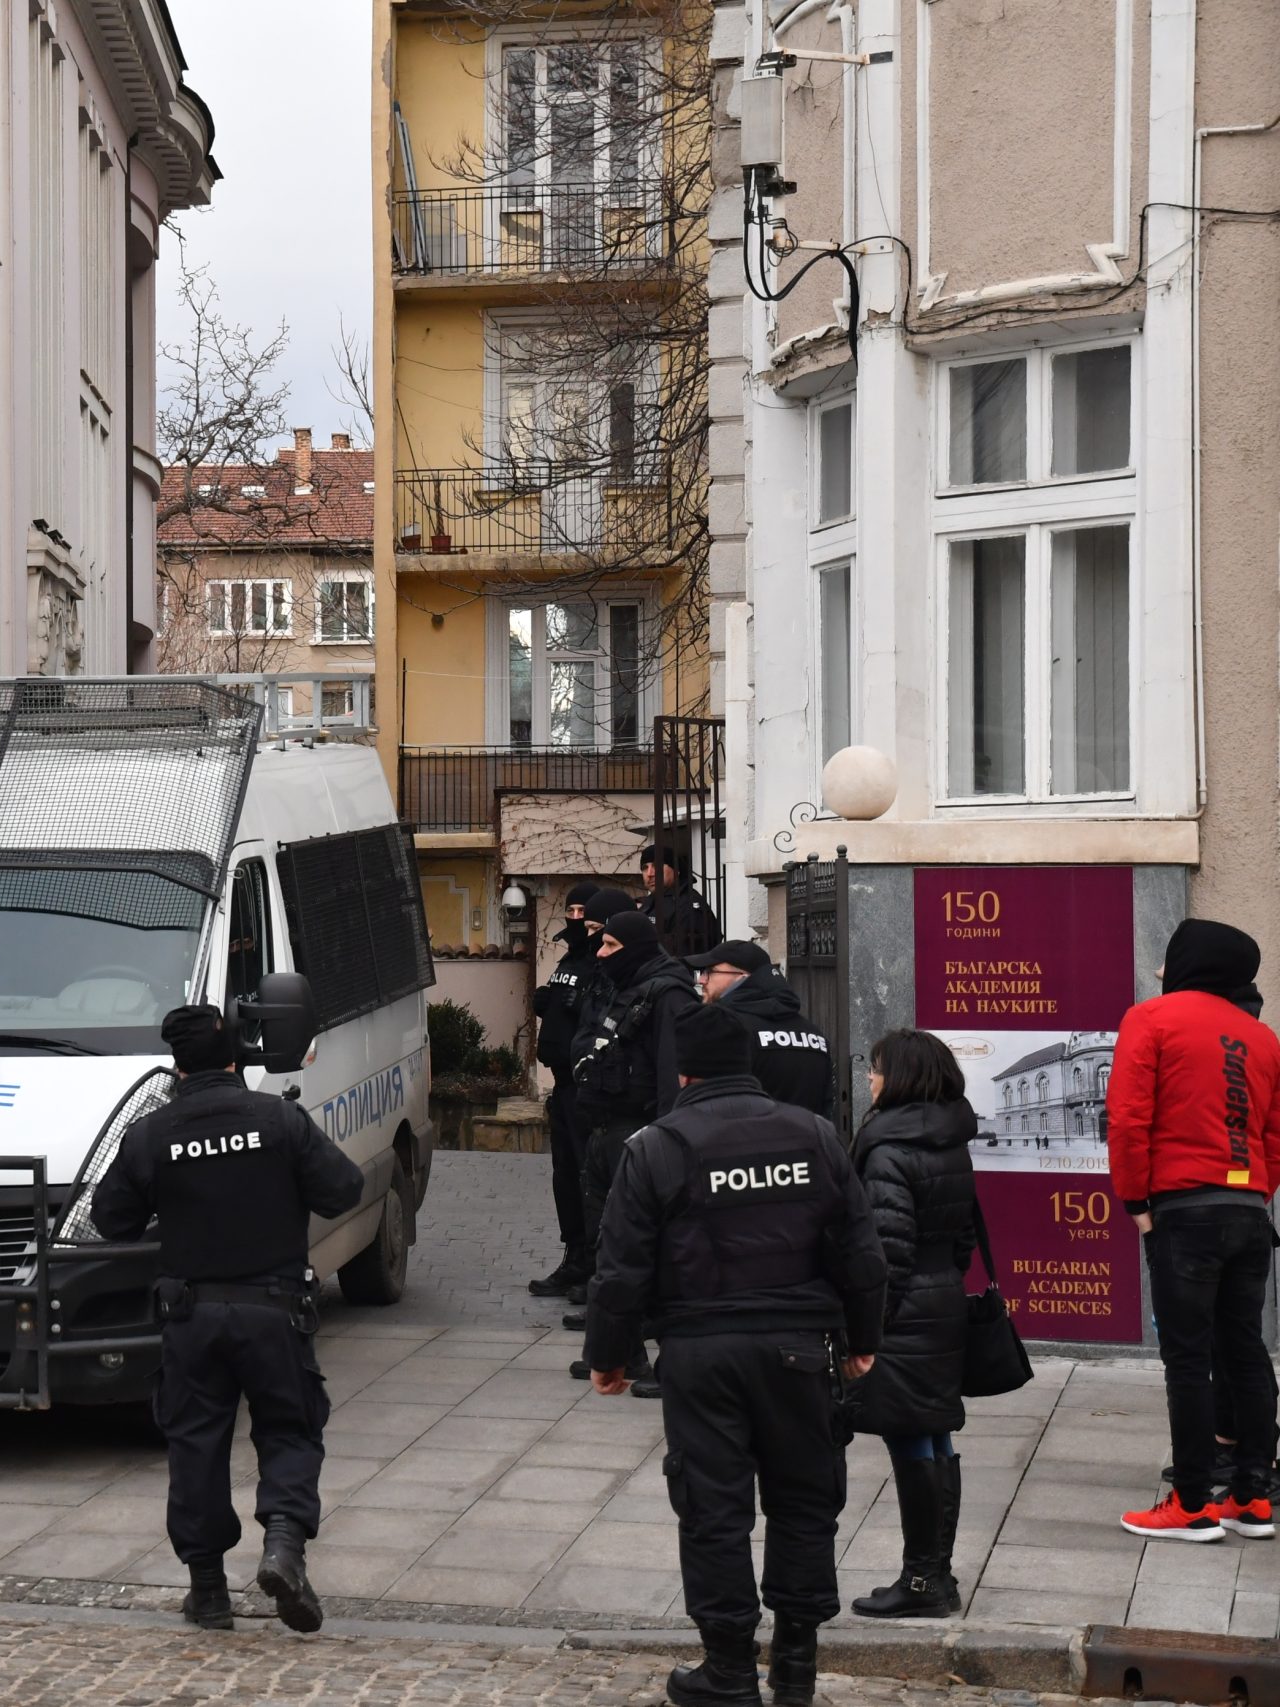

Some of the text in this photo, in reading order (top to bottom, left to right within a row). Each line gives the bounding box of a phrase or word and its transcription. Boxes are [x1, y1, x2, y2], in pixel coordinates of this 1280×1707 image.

[941, 891, 1000, 922] 150
[946, 928, 1000, 939] години
[945, 962, 1042, 975] БЪЛГАРСКА
[550, 973, 578, 986] OLICE
[945, 981, 1041, 995] АКАДЕМИЯ
[945, 1000, 1058, 1013] НА НАУКИТЕ
[757, 1031, 828, 1053] POLICE
[323, 1065, 404, 1143] ПОЛИЦИЯ
[1219, 1034, 1250, 1168] Superstar
[170, 1131, 261, 1161] POLICE
[709, 1162, 810, 1193] POLICE
[1050, 1192, 1110, 1223] 150
[1069, 1229, 1110, 1241] years
[1013, 1260, 1111, 1276] BULGARIAN
[1028, 1280, 1112, 1295] ACADEMY
[1028, 1300, 1112, 1315] SCIENCES
